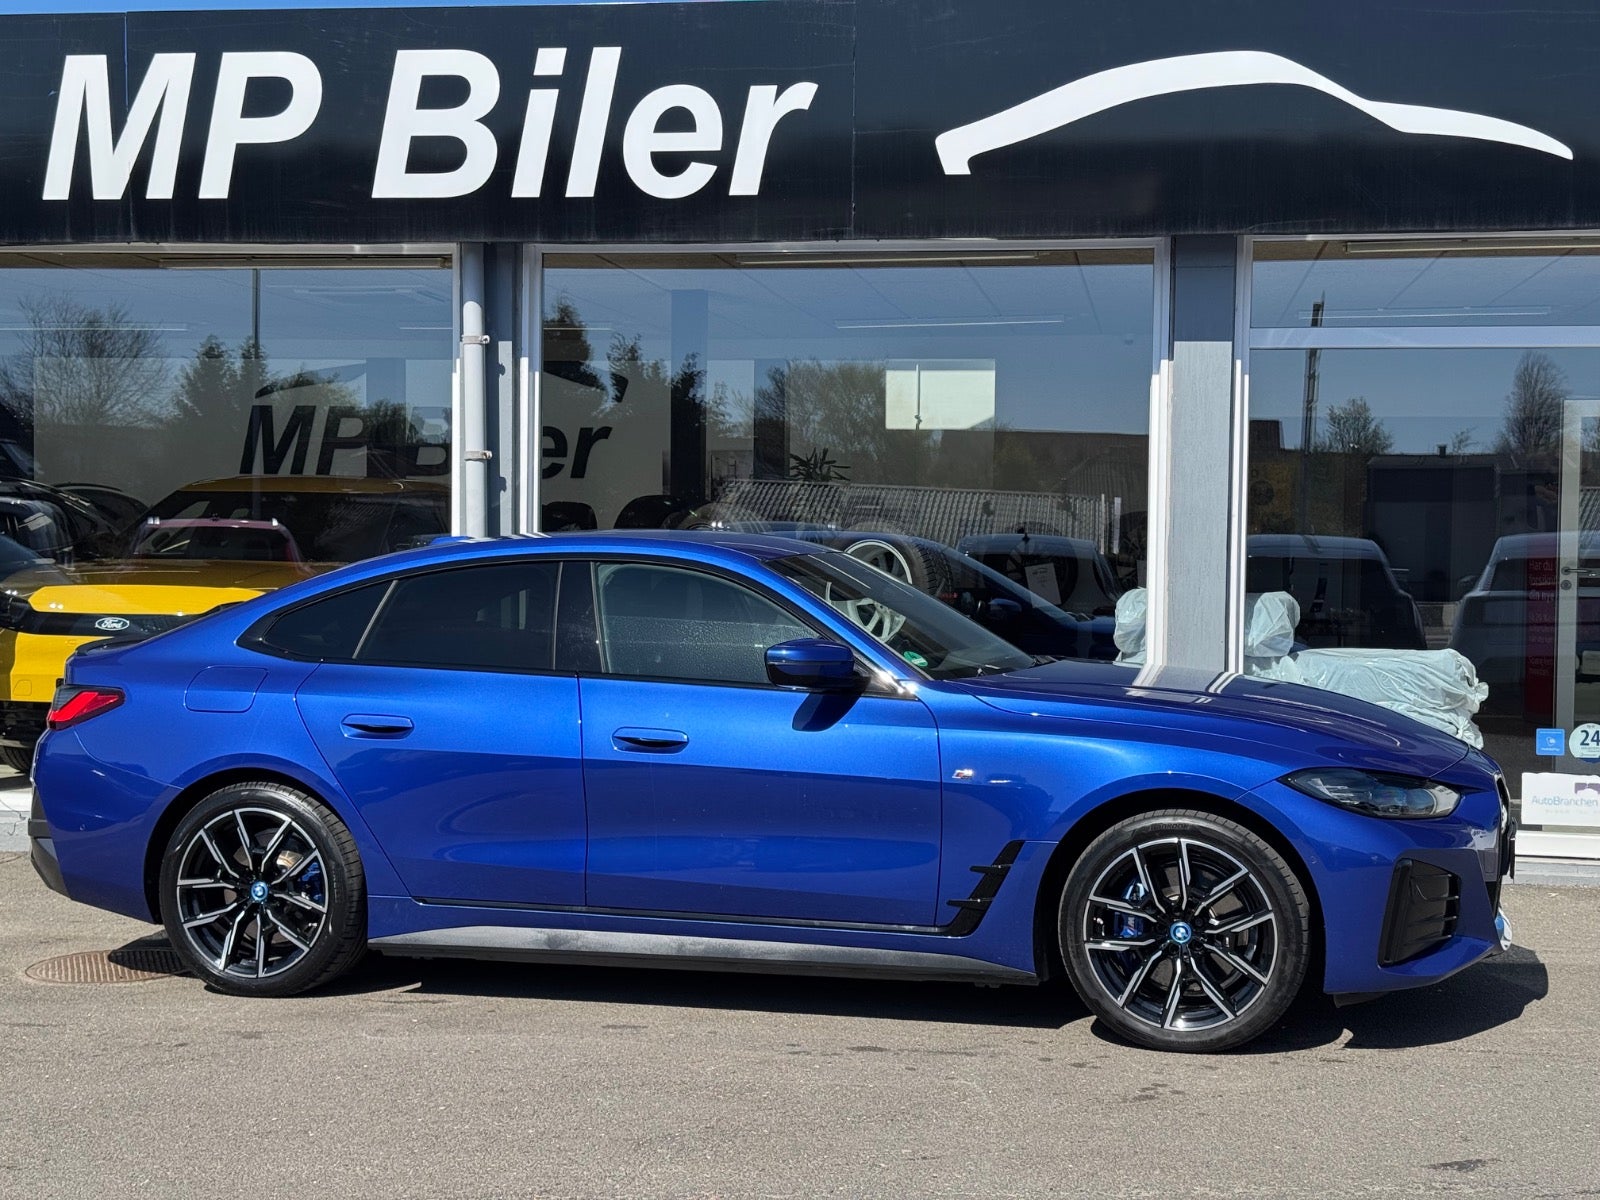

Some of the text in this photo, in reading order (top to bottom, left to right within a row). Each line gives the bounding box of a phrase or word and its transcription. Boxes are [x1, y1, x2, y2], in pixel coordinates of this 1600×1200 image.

[42, 46, 819, 200] MP Biler
[239, 404, 369, 476] MP
[101, 619, 123, 628] Ford
[1580, 730, 1600, 746] 24
[1532, 795, 1599, 806] AutoBranchen
